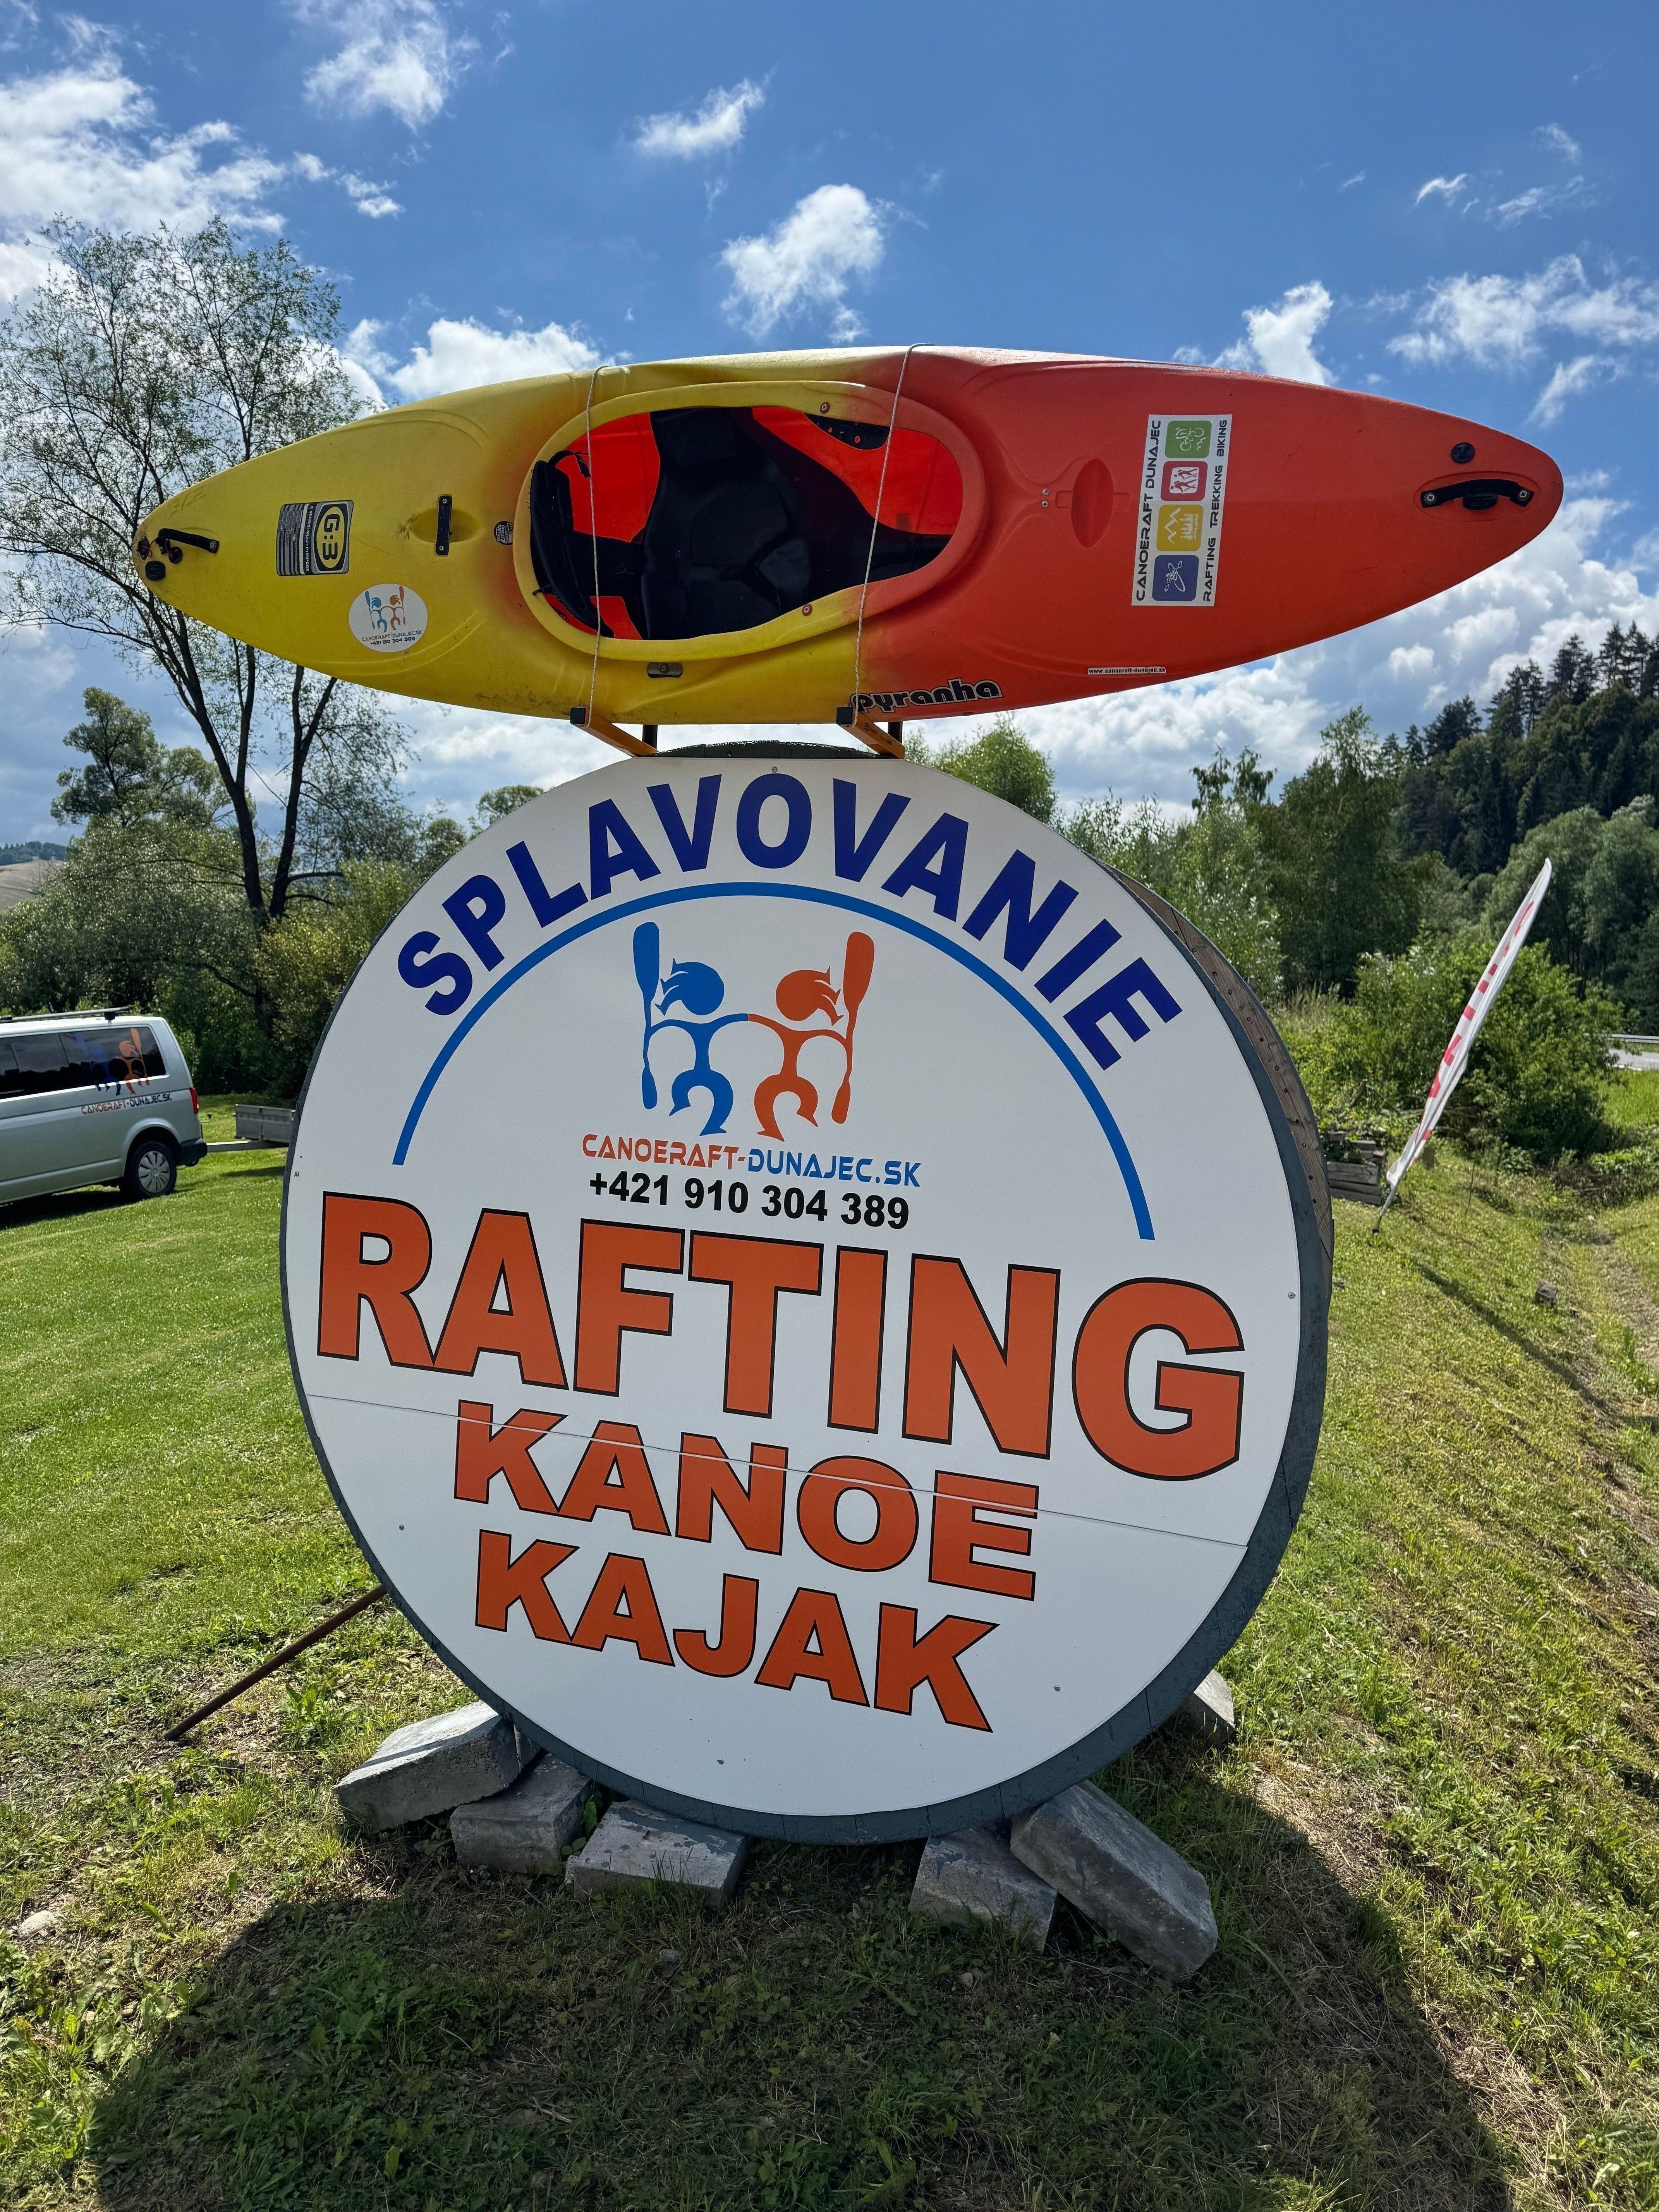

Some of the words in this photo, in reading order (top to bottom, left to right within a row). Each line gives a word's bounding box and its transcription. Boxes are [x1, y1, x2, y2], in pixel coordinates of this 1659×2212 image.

[1137, 493, 1153, 601] CANOERAFT
[1146, 420, 1161, 488] DUNAJEC
[1203, 538, 1216, 602] RAFTING
[1210, 465, 1223, 528] TREKKING
[1217, 420, 1227, 457] BIKING
[850, 678, 1002, 713] pyranha
[398, 773, 1182, 1070] SPLAVOVANIE
[582, 1134, 921, 1188] CANOERAFT-DUNAJEC.SK
[590, 1170, 668, 1206] +421
[684, 1178, 748, 1213] 910
[761, 1185, 828, 1221] 304
[840, 1193, 909, 1230] 389
[317, 1191, 1245, 1481] RAFTING
[454, 1399, 1039, 1601] KANOE
[475, 1529, 999, 1733] KAJAK
